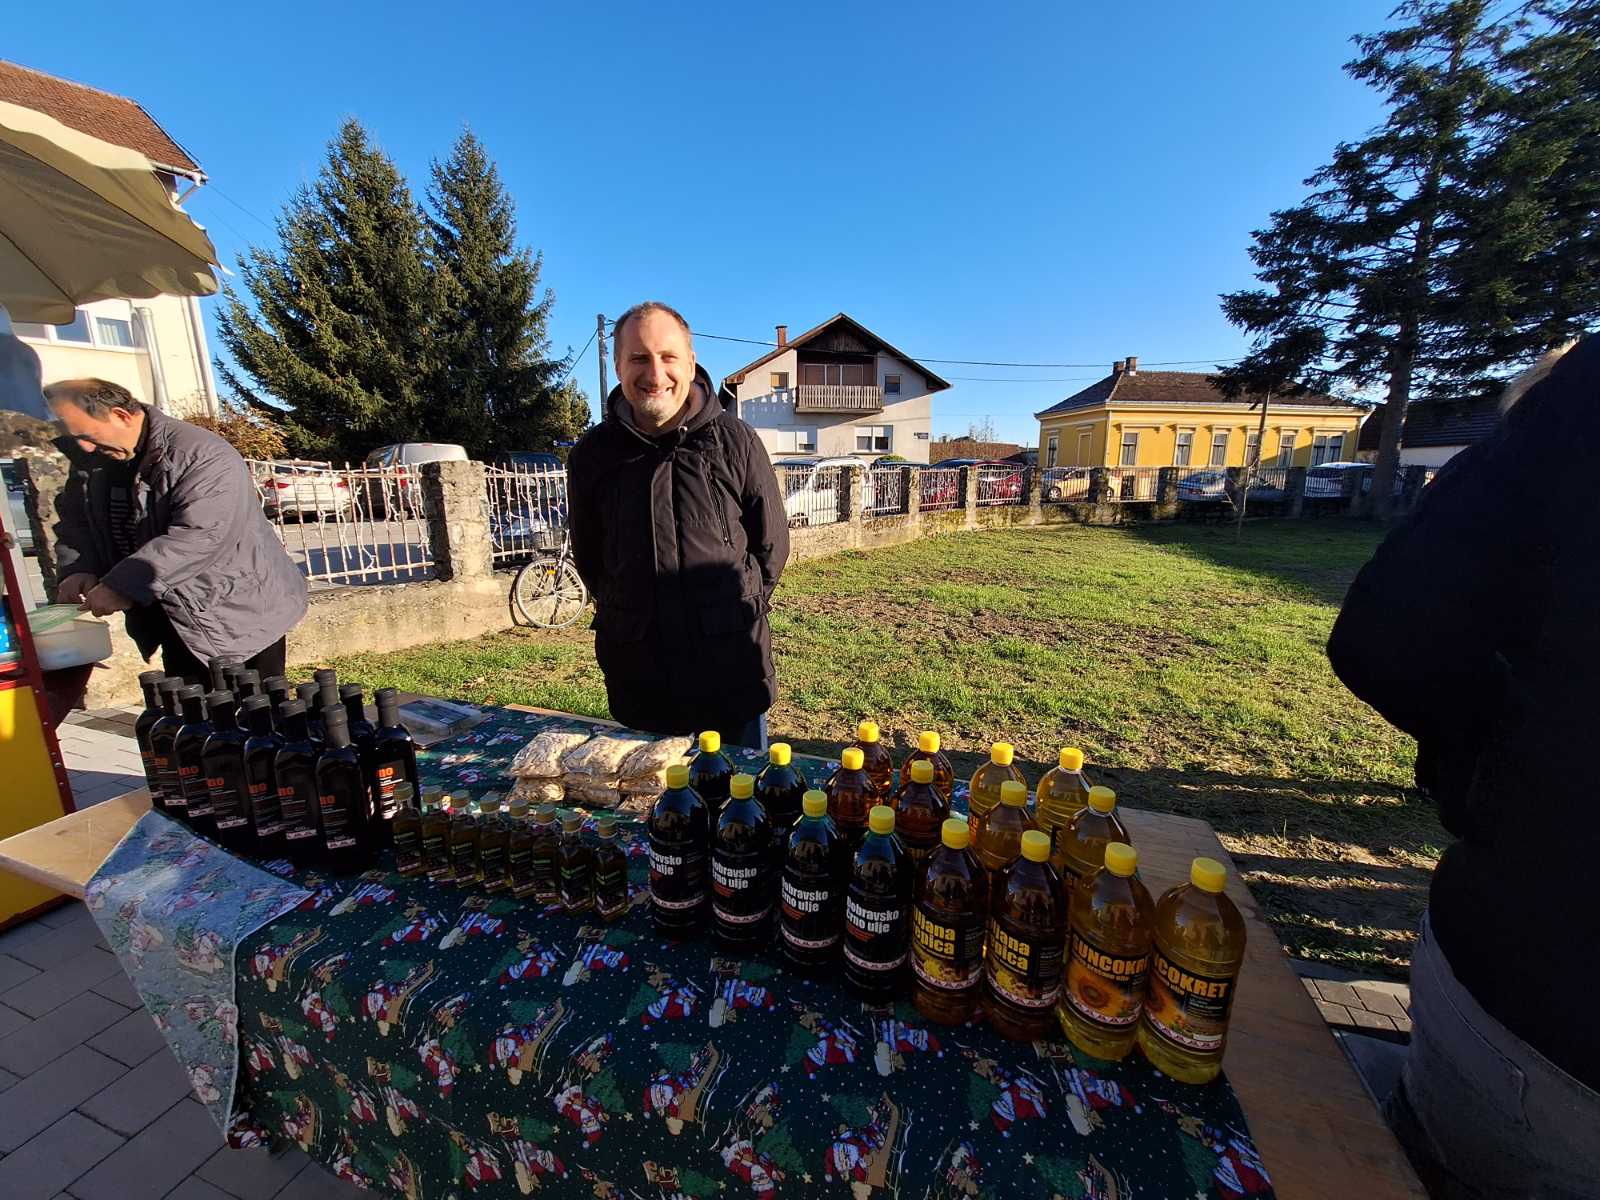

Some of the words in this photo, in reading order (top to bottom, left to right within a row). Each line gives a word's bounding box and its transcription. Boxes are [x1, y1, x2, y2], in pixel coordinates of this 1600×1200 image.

[655, 861, 675, 876] ulje
[728, 878, 749, 890] ulje
[798, 900, 820, 913] ulje
[846, 895, 900, 922] Dobravsko
[867, 921, 890, 934] ulje
[990, 933, 1029, 971] epica
